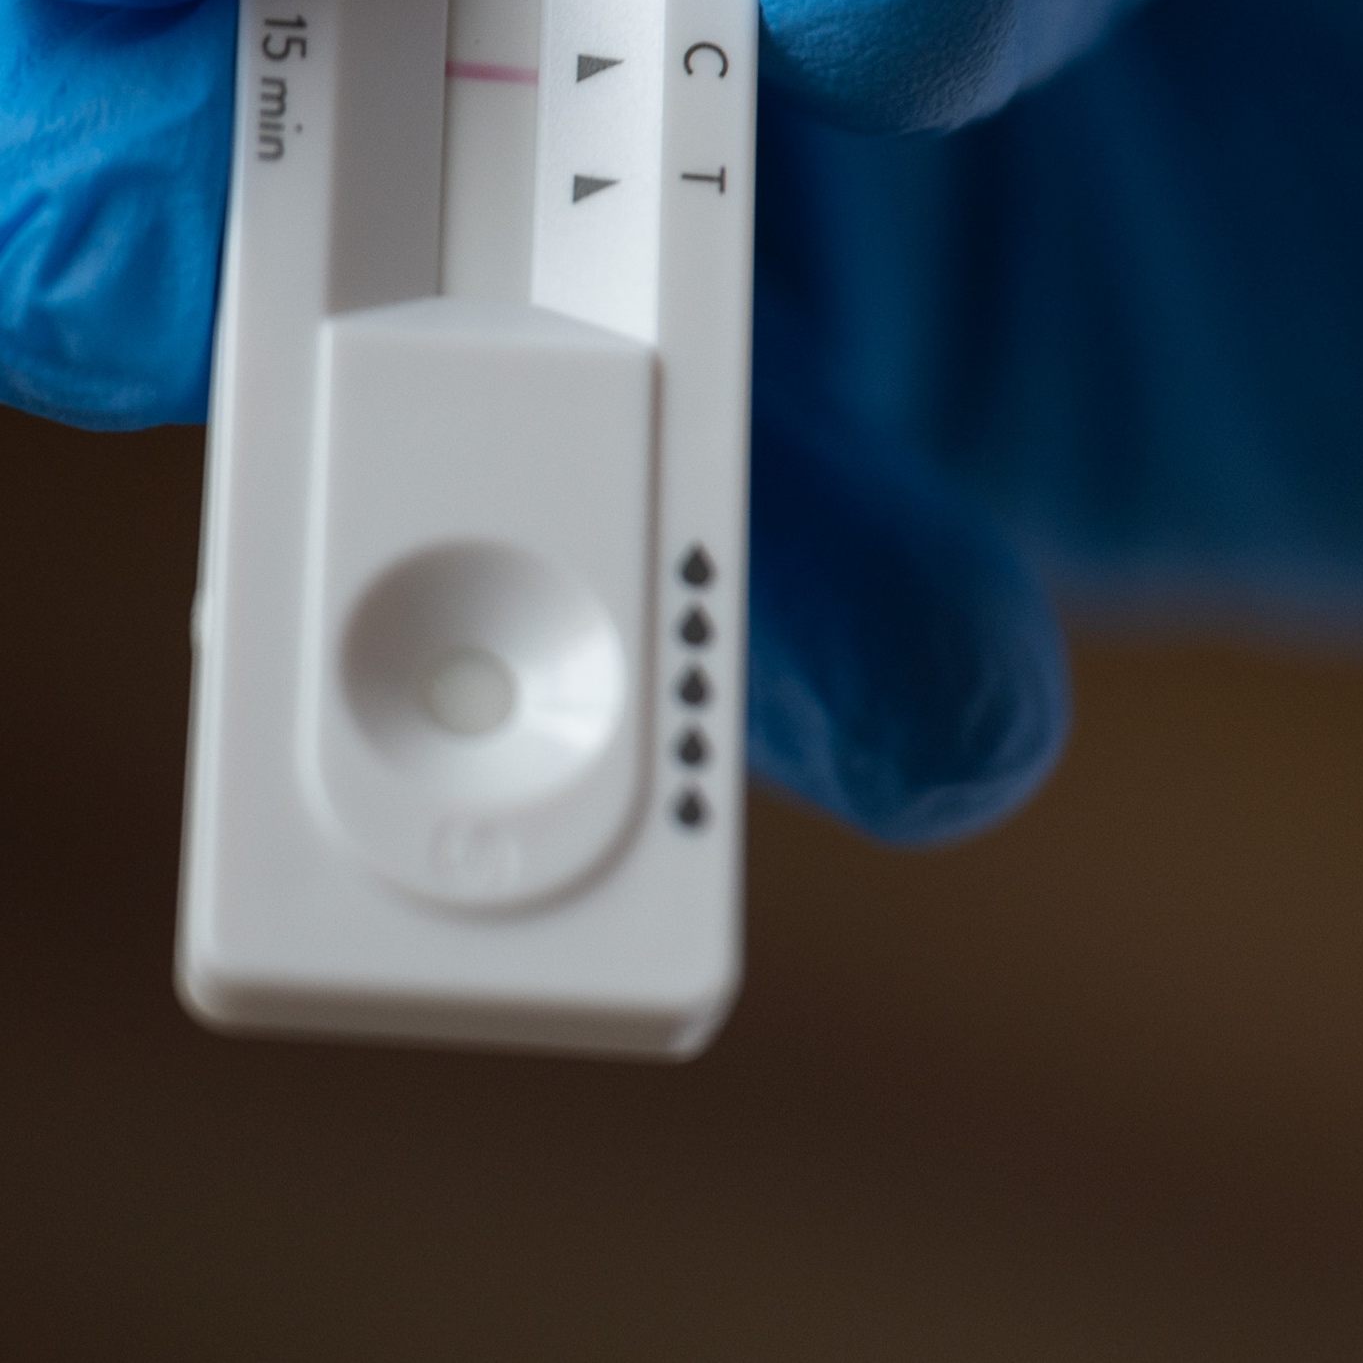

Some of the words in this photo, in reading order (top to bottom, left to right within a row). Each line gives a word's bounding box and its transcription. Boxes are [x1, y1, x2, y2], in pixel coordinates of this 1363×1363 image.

[262, 14, 308, 61] 15
[683, 41, 729, 79] C
[257, 77, 303, 162] min
[681, 167, 726, 195] T
